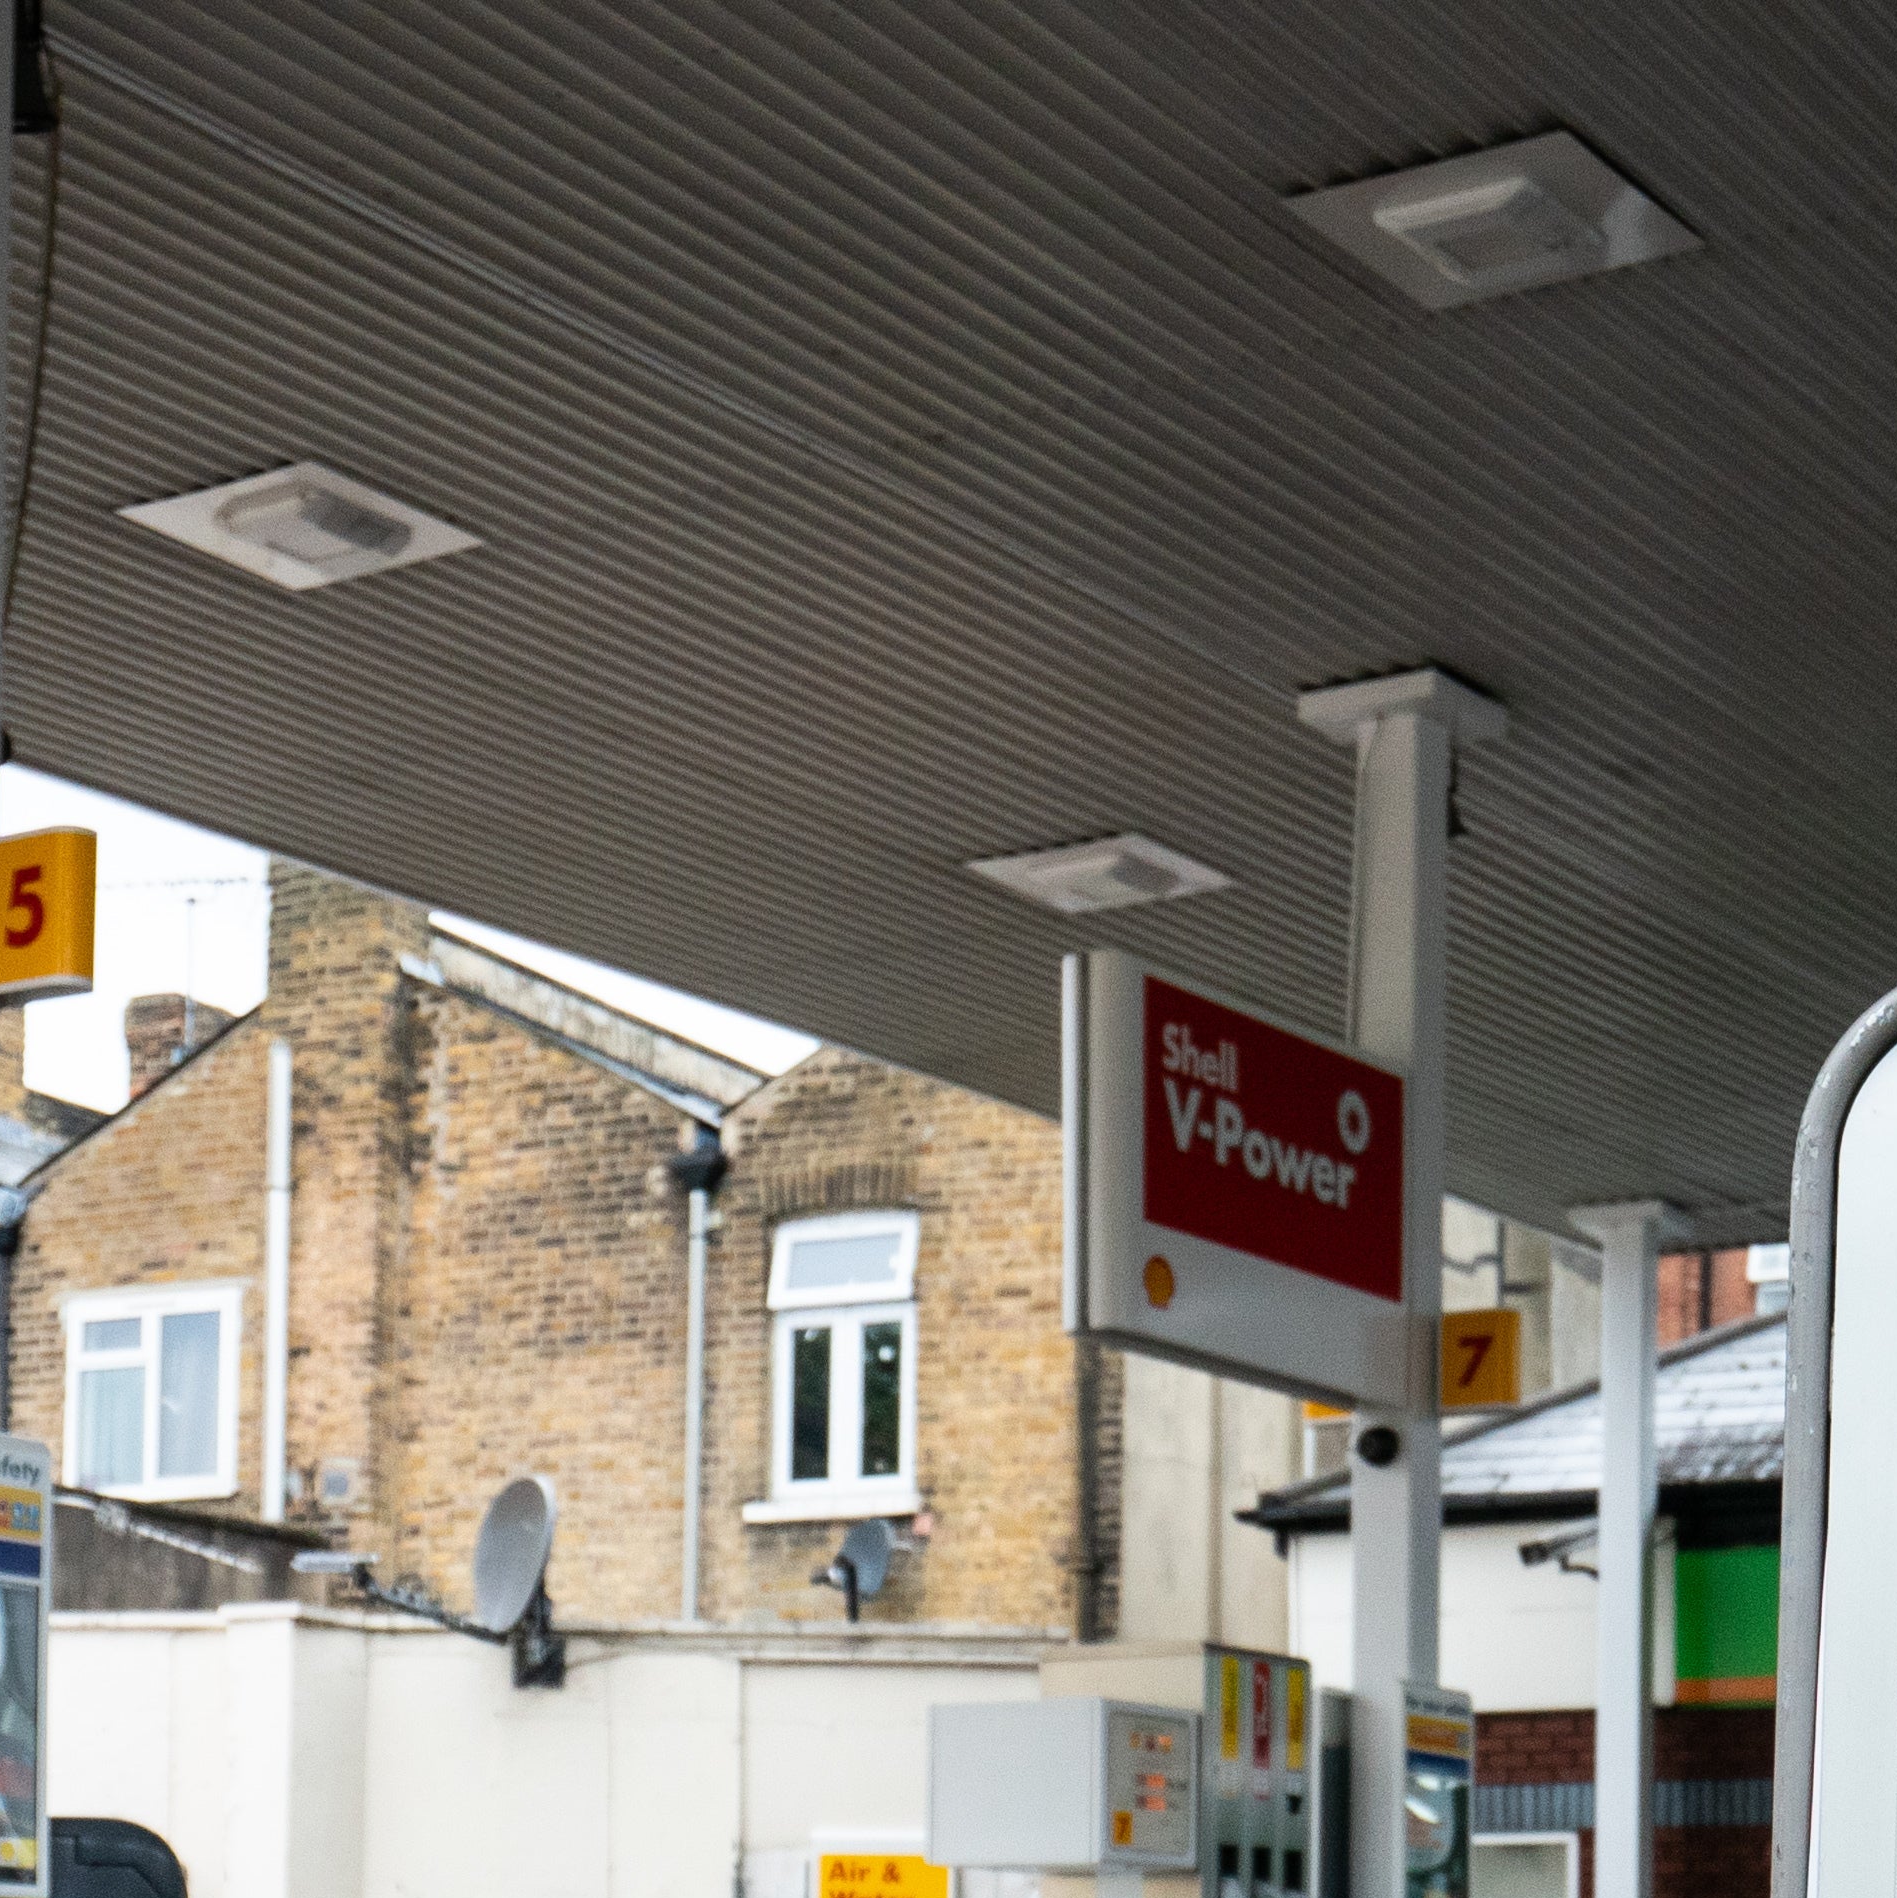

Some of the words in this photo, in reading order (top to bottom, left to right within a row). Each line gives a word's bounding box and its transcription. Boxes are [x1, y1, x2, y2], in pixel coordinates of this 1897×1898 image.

[3, 863, 44, 949] 5
[1162, 1021, 1240, 1092] Shell
[1164, 1078, 1358, 1210] V-Power
[1457, 1335, 1493, 1388] 7
[828, 1860, 870, 1883] Air
[882, 1860, 900, 1884] &
